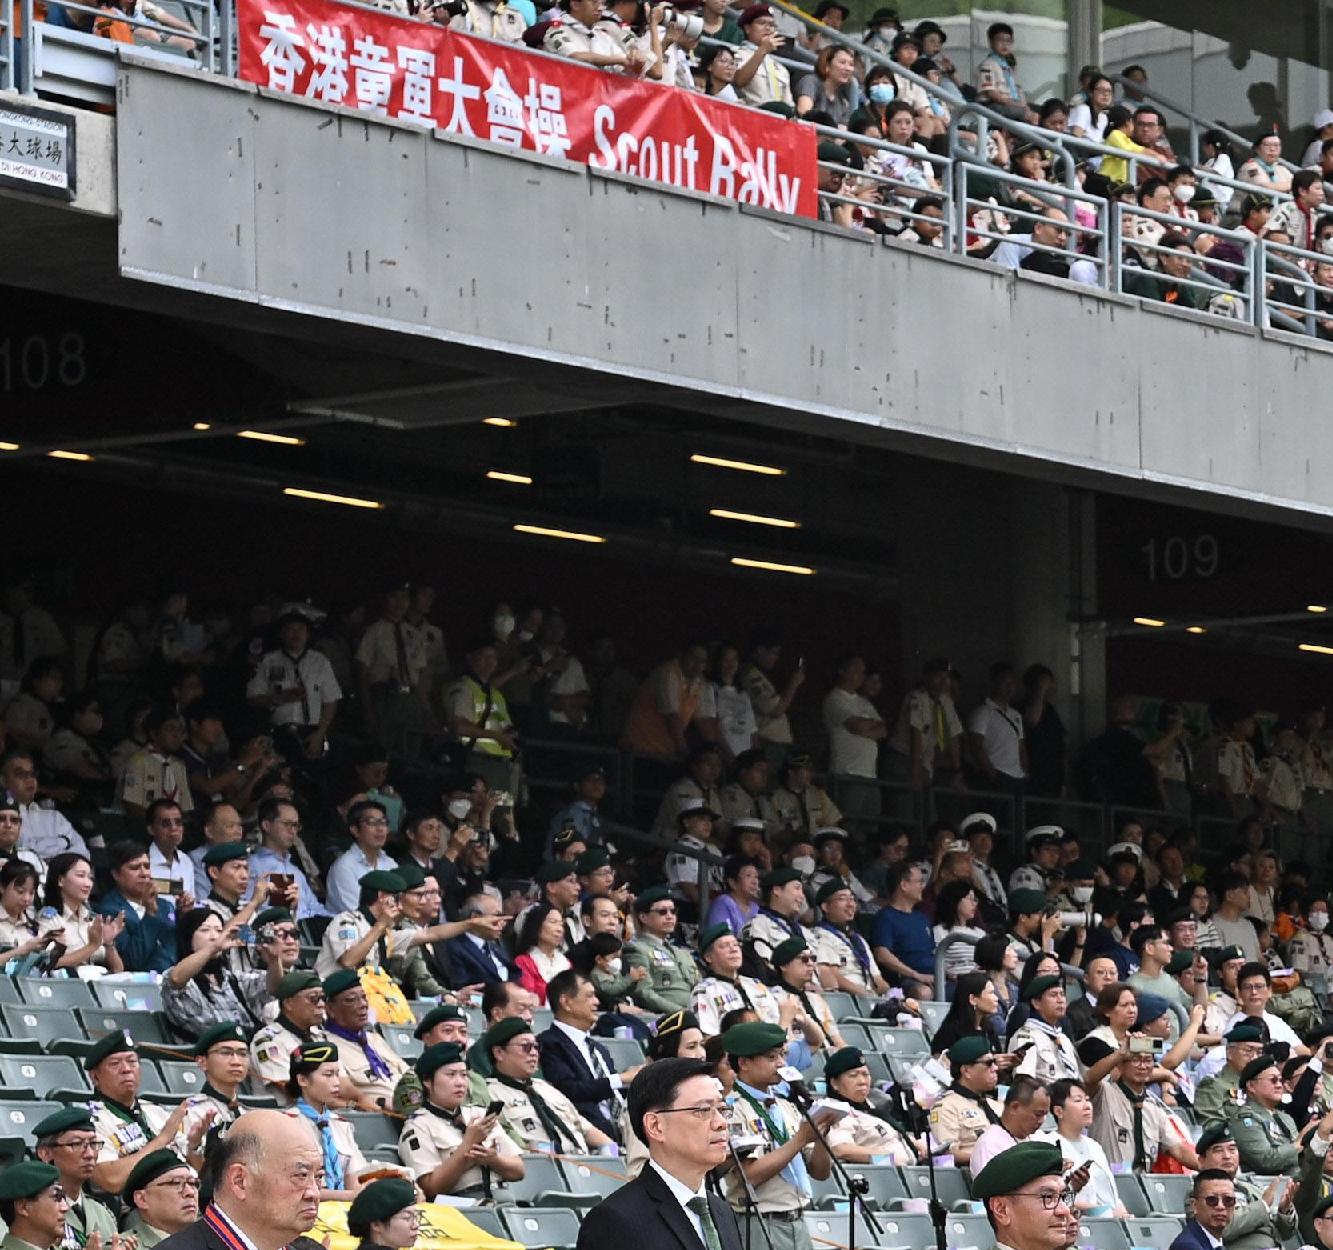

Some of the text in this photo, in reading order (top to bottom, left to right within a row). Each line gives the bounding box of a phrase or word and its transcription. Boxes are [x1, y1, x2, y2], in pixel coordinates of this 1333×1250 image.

[259, 10, 801, 214] 香港童軍大會操 Scout Rally
[0, 131, 63, 166] 大球場
[1141, 533, 1219, 582] 109
